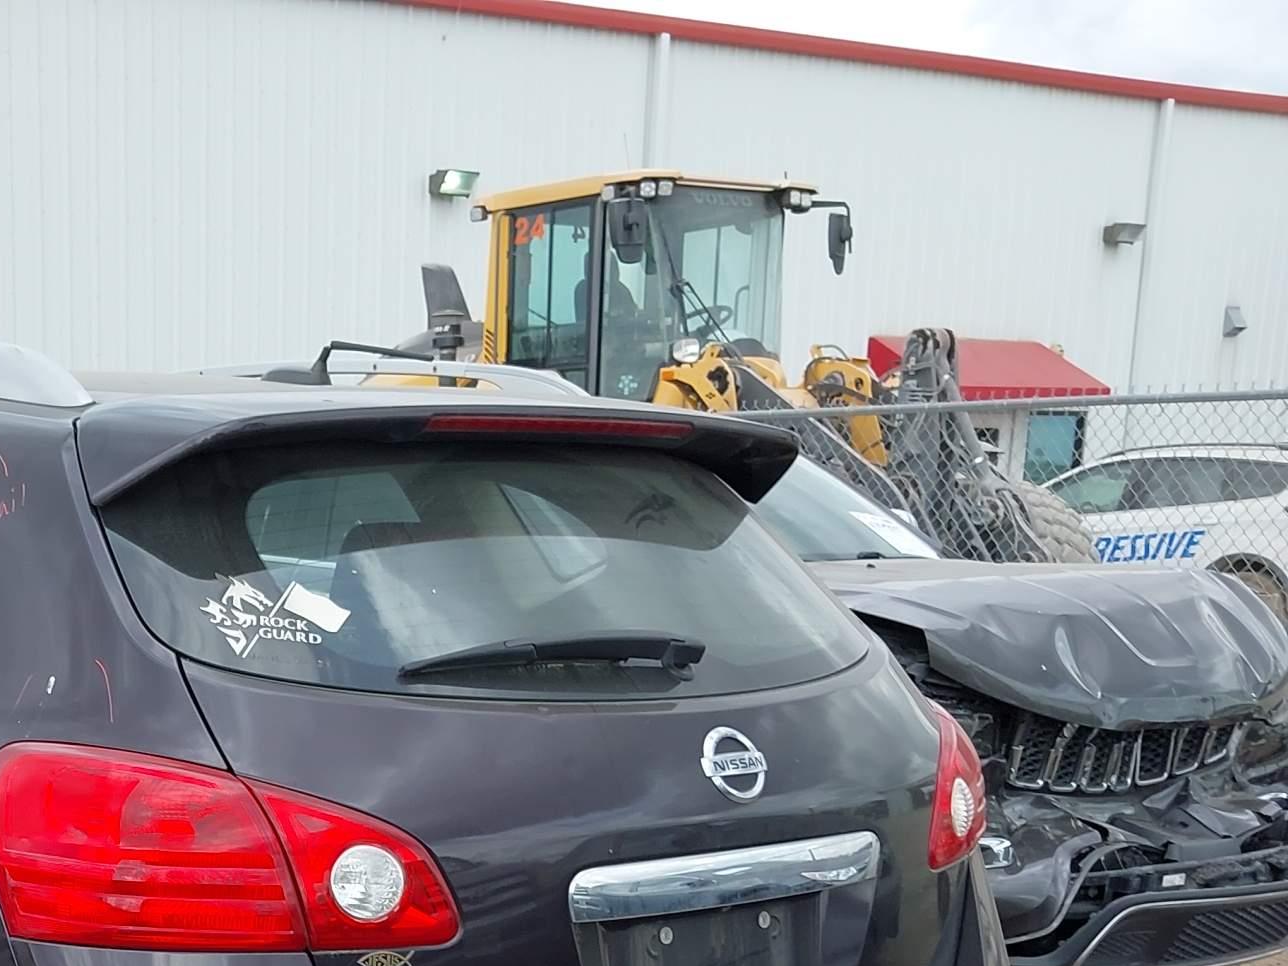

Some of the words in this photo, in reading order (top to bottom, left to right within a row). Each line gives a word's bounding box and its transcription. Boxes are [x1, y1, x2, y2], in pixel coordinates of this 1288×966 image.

[692, 191, 753, 207] VOLVO
[514, 213, 545, 246] 24
[259, 614, 310, 632] ROCK
[258, 627, 323, 645] GUARD
[712, 756, 764, 772] NISSAN
